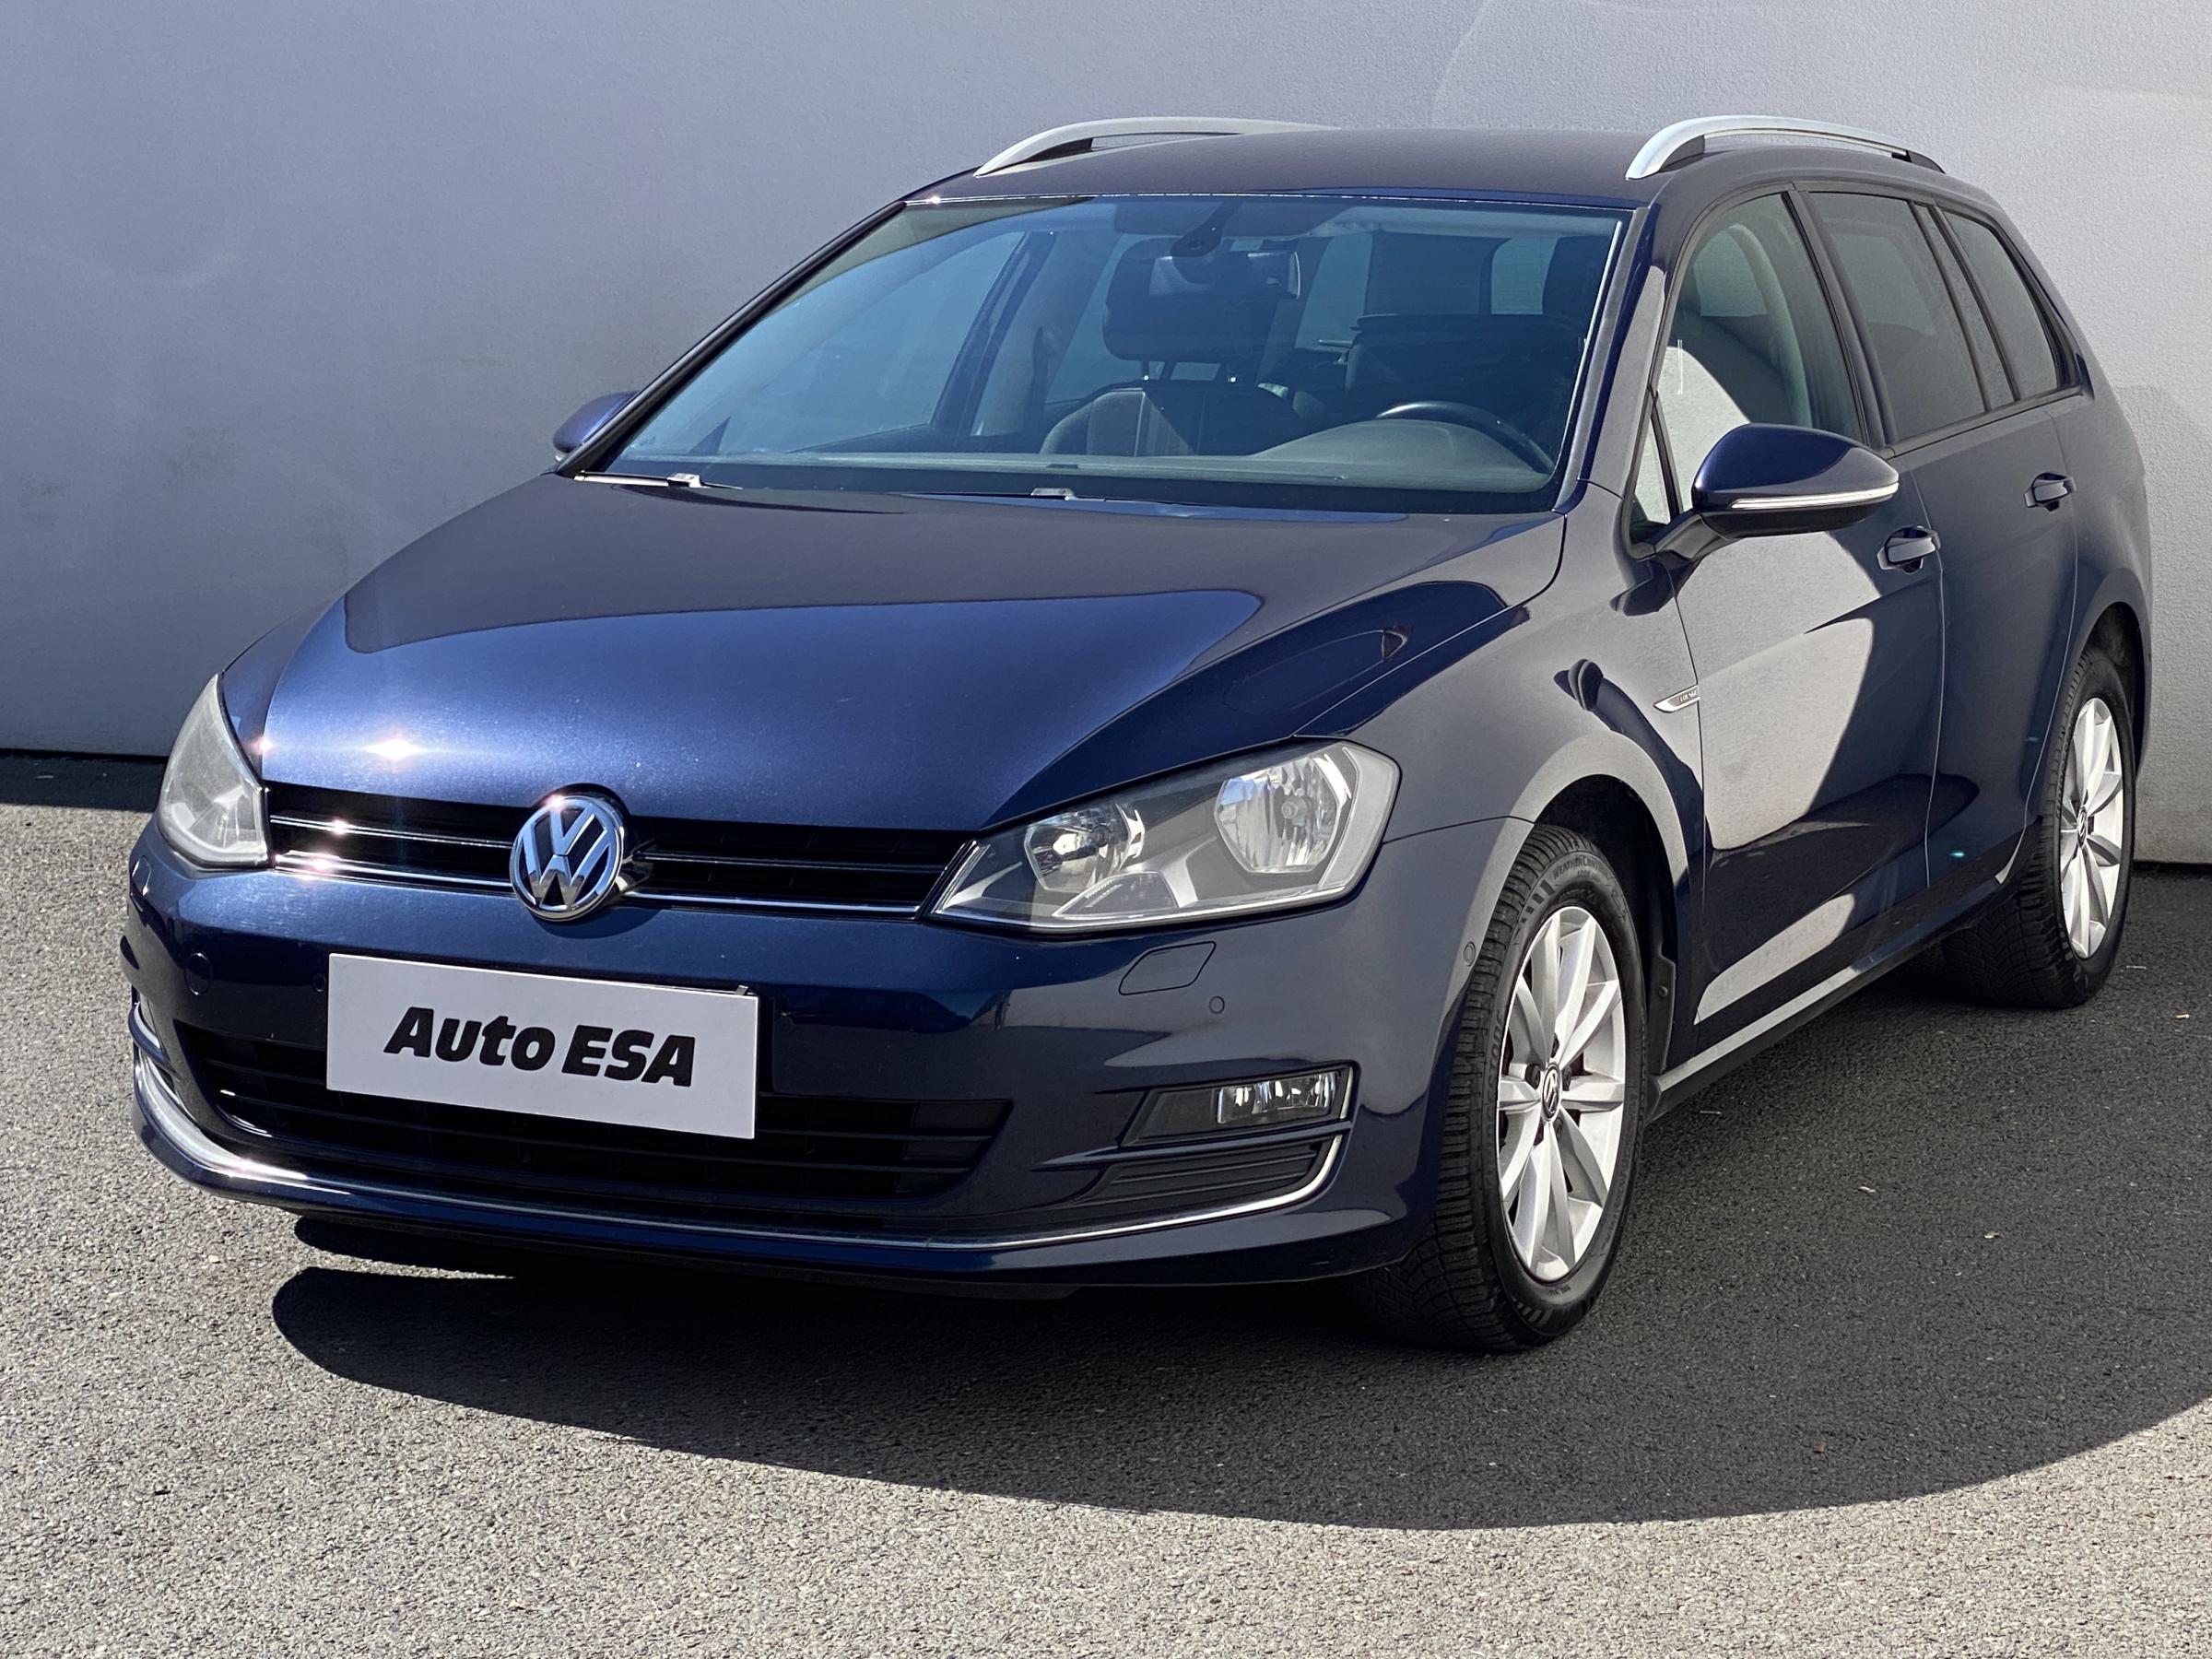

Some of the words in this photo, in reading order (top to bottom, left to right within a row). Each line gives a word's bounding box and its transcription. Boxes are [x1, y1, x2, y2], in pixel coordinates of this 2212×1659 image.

[512, 798, 622, 920] VW
[383, 1006, 556, 1071] Auto
[561, 1024, 696, 1088] ESA
